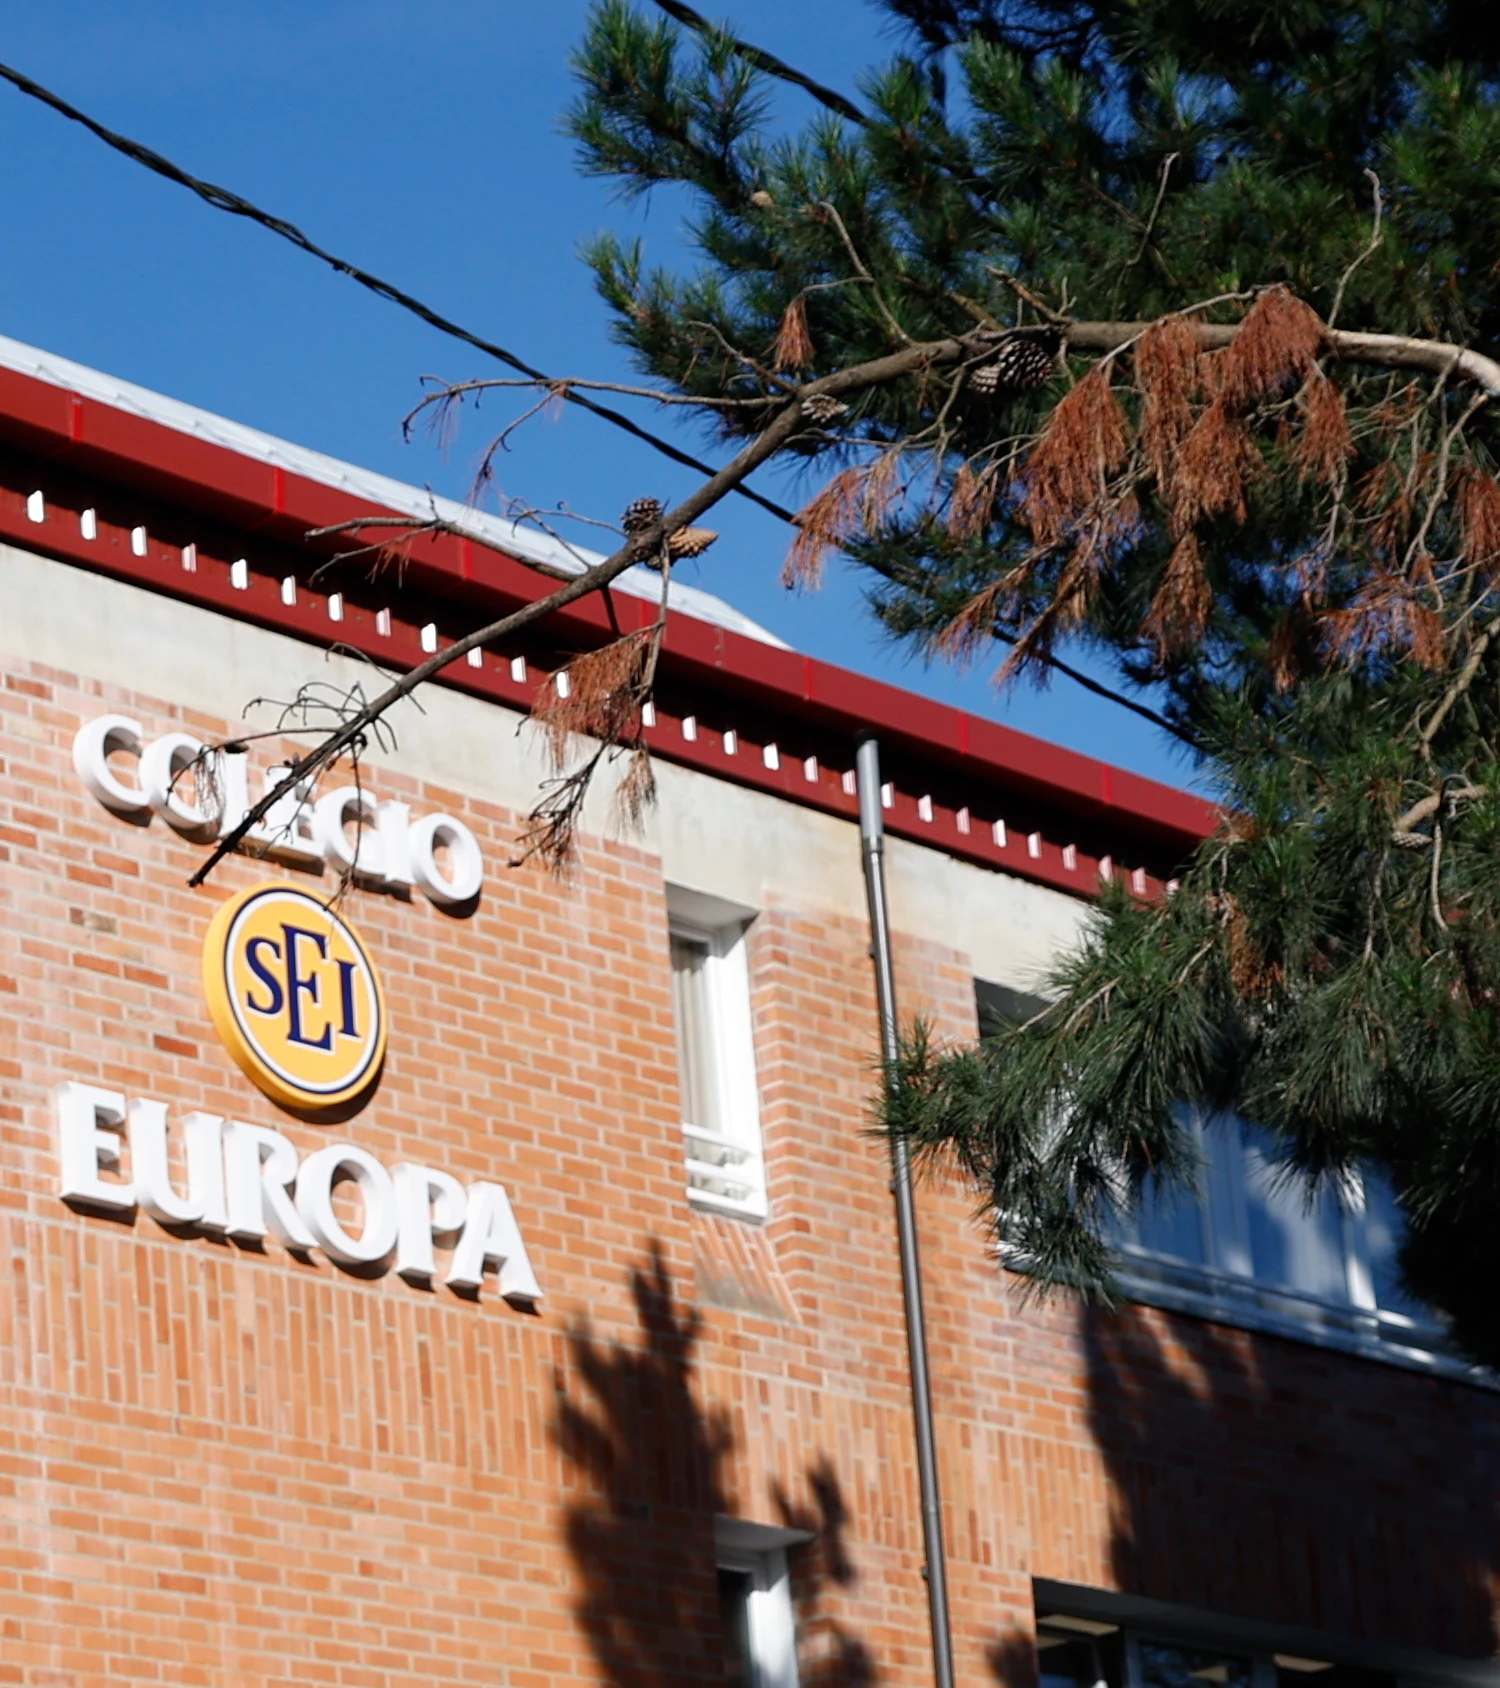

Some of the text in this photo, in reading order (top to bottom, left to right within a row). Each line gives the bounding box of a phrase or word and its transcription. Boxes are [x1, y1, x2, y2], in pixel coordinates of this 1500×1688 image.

[72, 713, 484, 904] COLEGIO
[243, 921, 362, 1053] SEI
[57, 1081, 544, 1300] EUROPA
